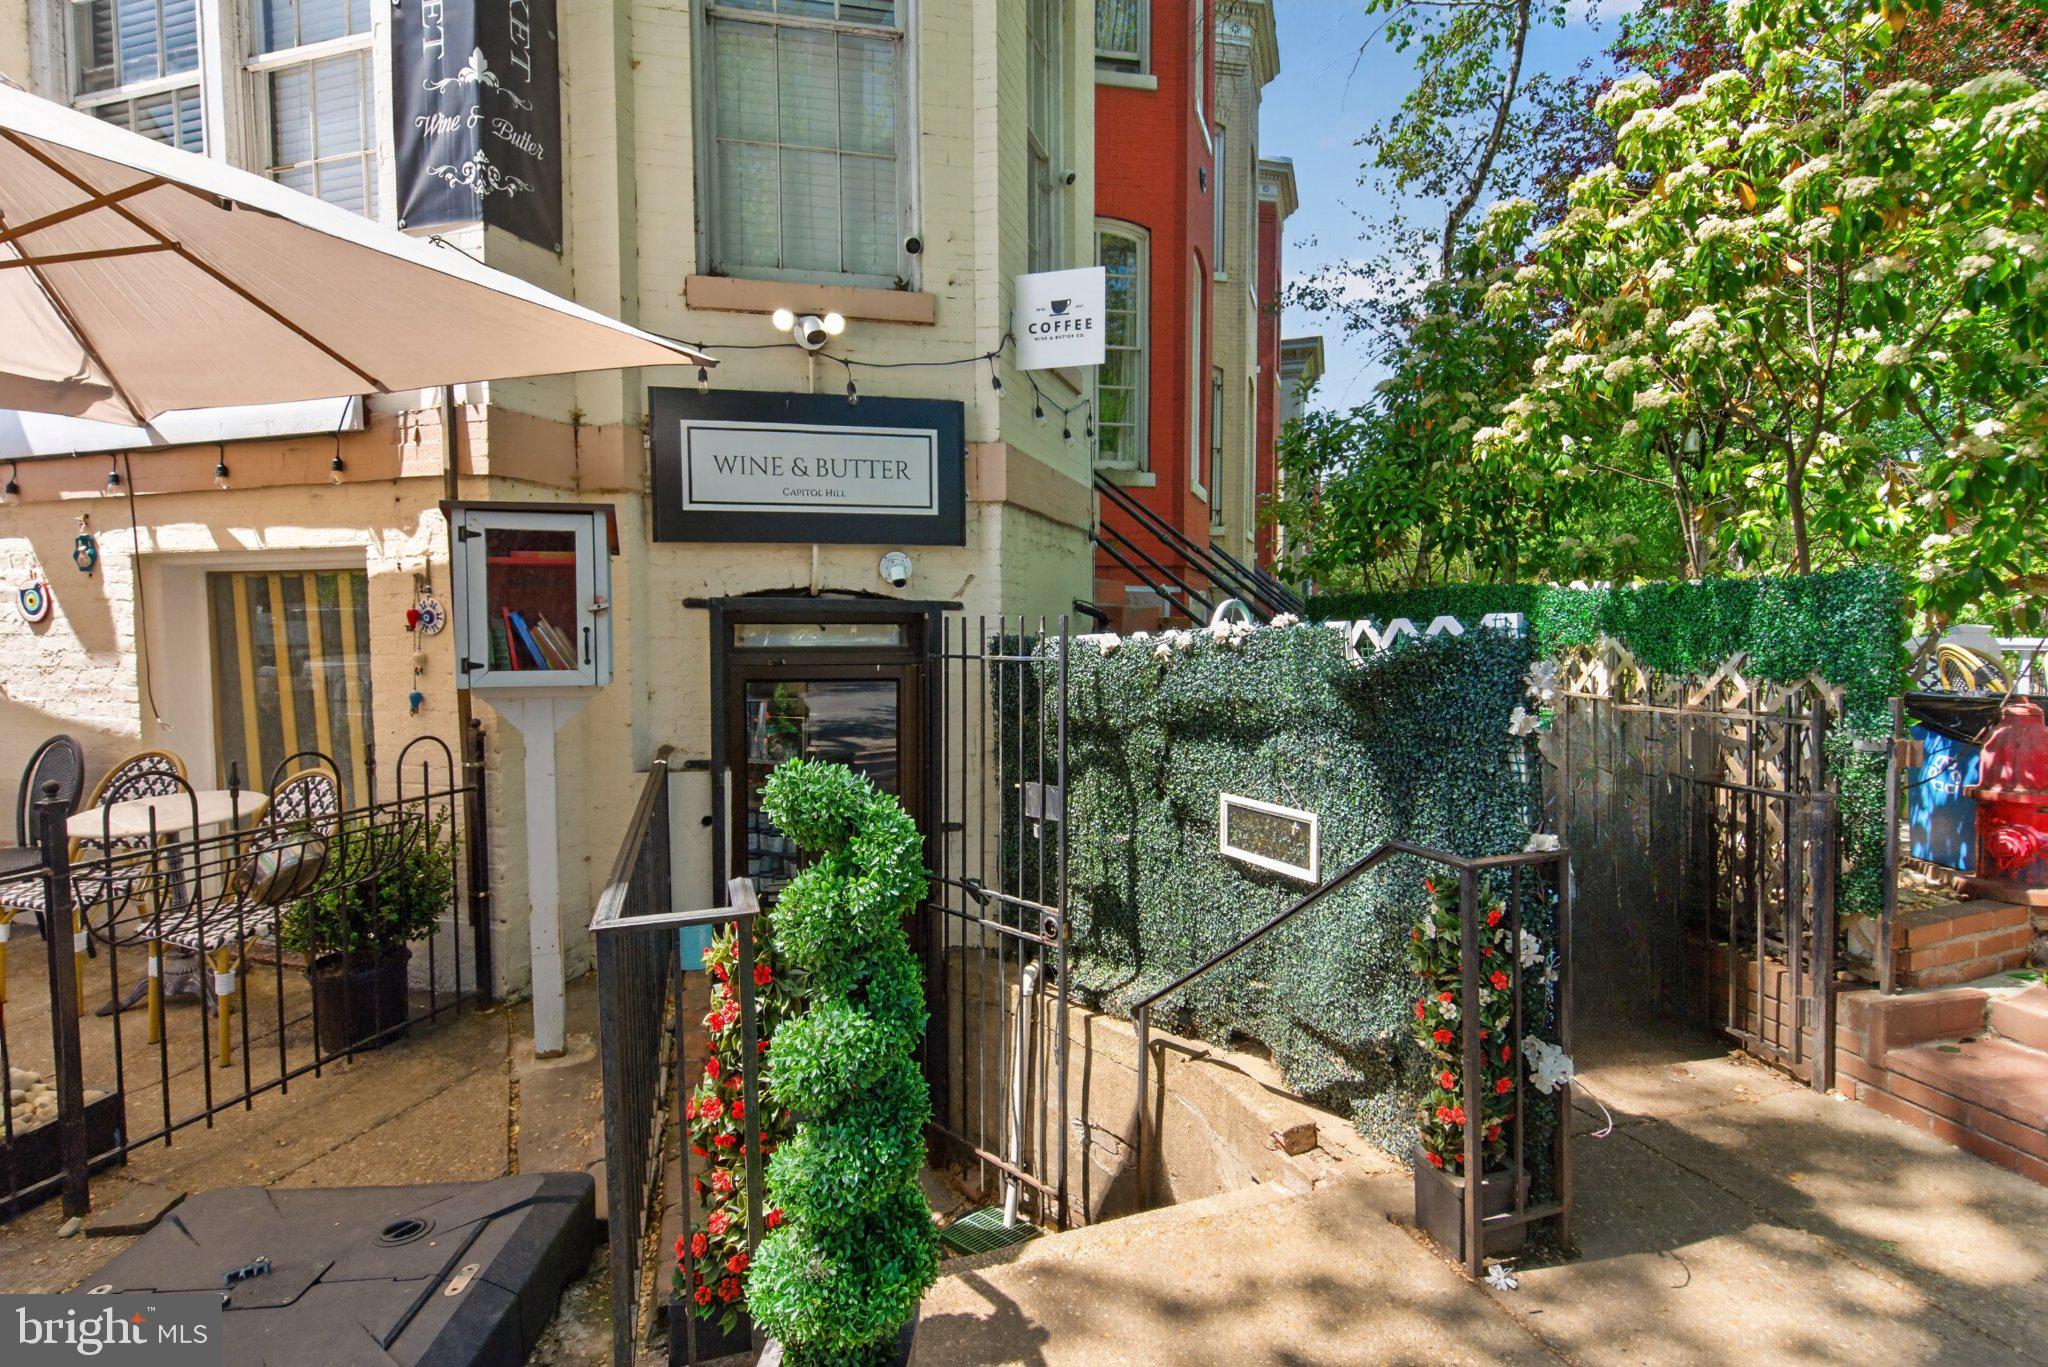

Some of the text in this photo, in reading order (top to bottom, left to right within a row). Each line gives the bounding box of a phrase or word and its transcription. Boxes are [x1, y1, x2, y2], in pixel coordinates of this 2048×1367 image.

[415, 105, 544, 160] Wine & Butter
[1028, 318, 1092, 334] COFFEE
[713, 454, 912, 480] WINE & BUTTER
